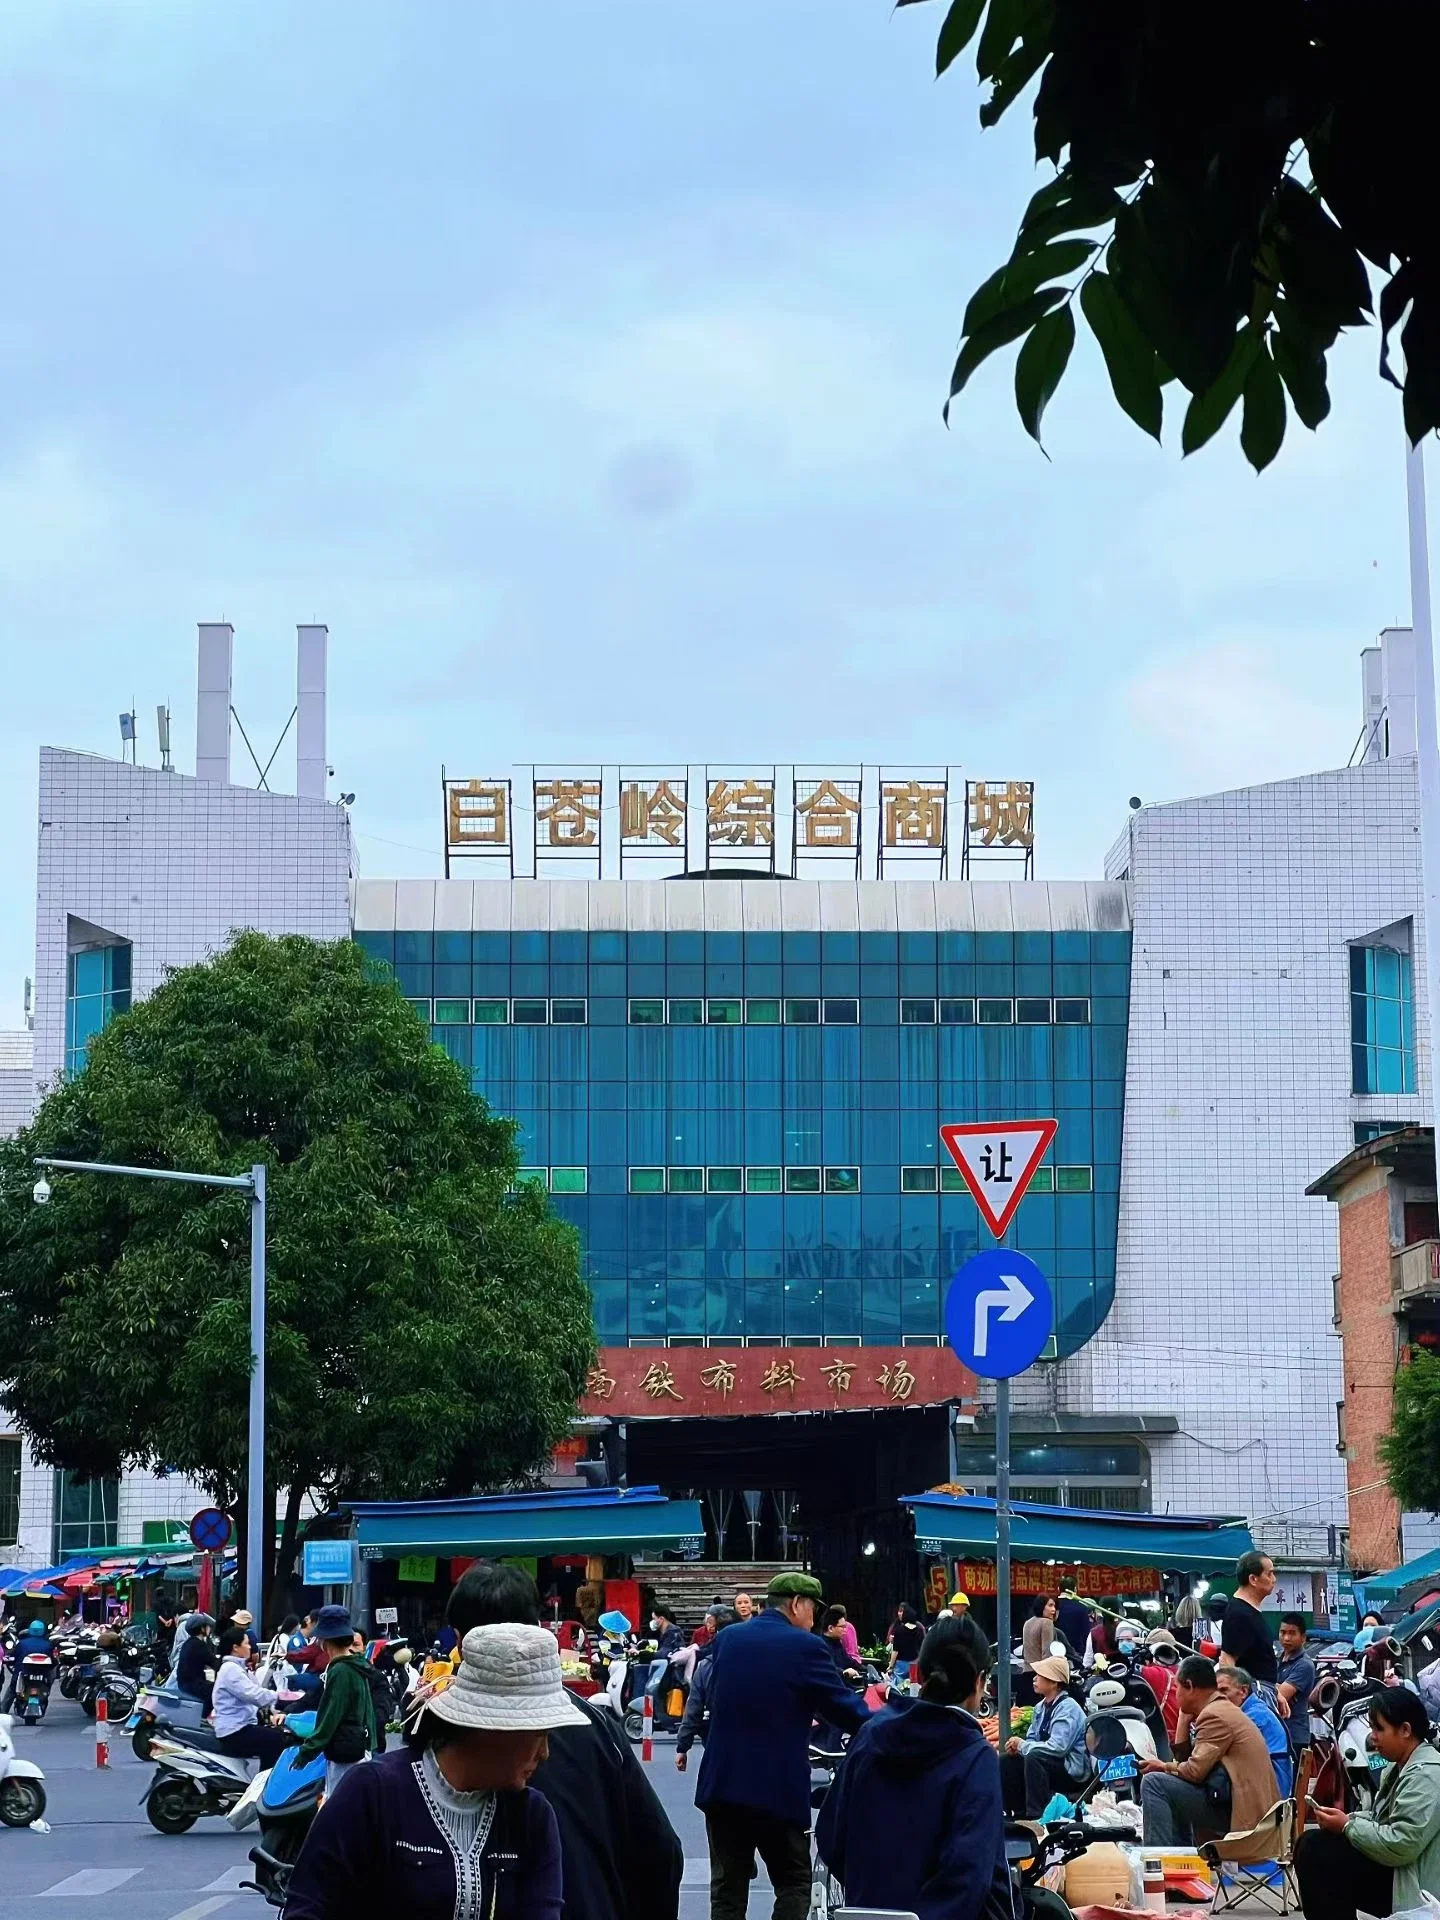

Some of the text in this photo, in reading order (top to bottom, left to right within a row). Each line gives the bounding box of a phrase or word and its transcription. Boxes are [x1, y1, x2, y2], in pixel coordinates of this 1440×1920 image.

[449, 780, 1035, 846] 白苍岭综合商城
[980, 1141, 1013, 1183] 让
